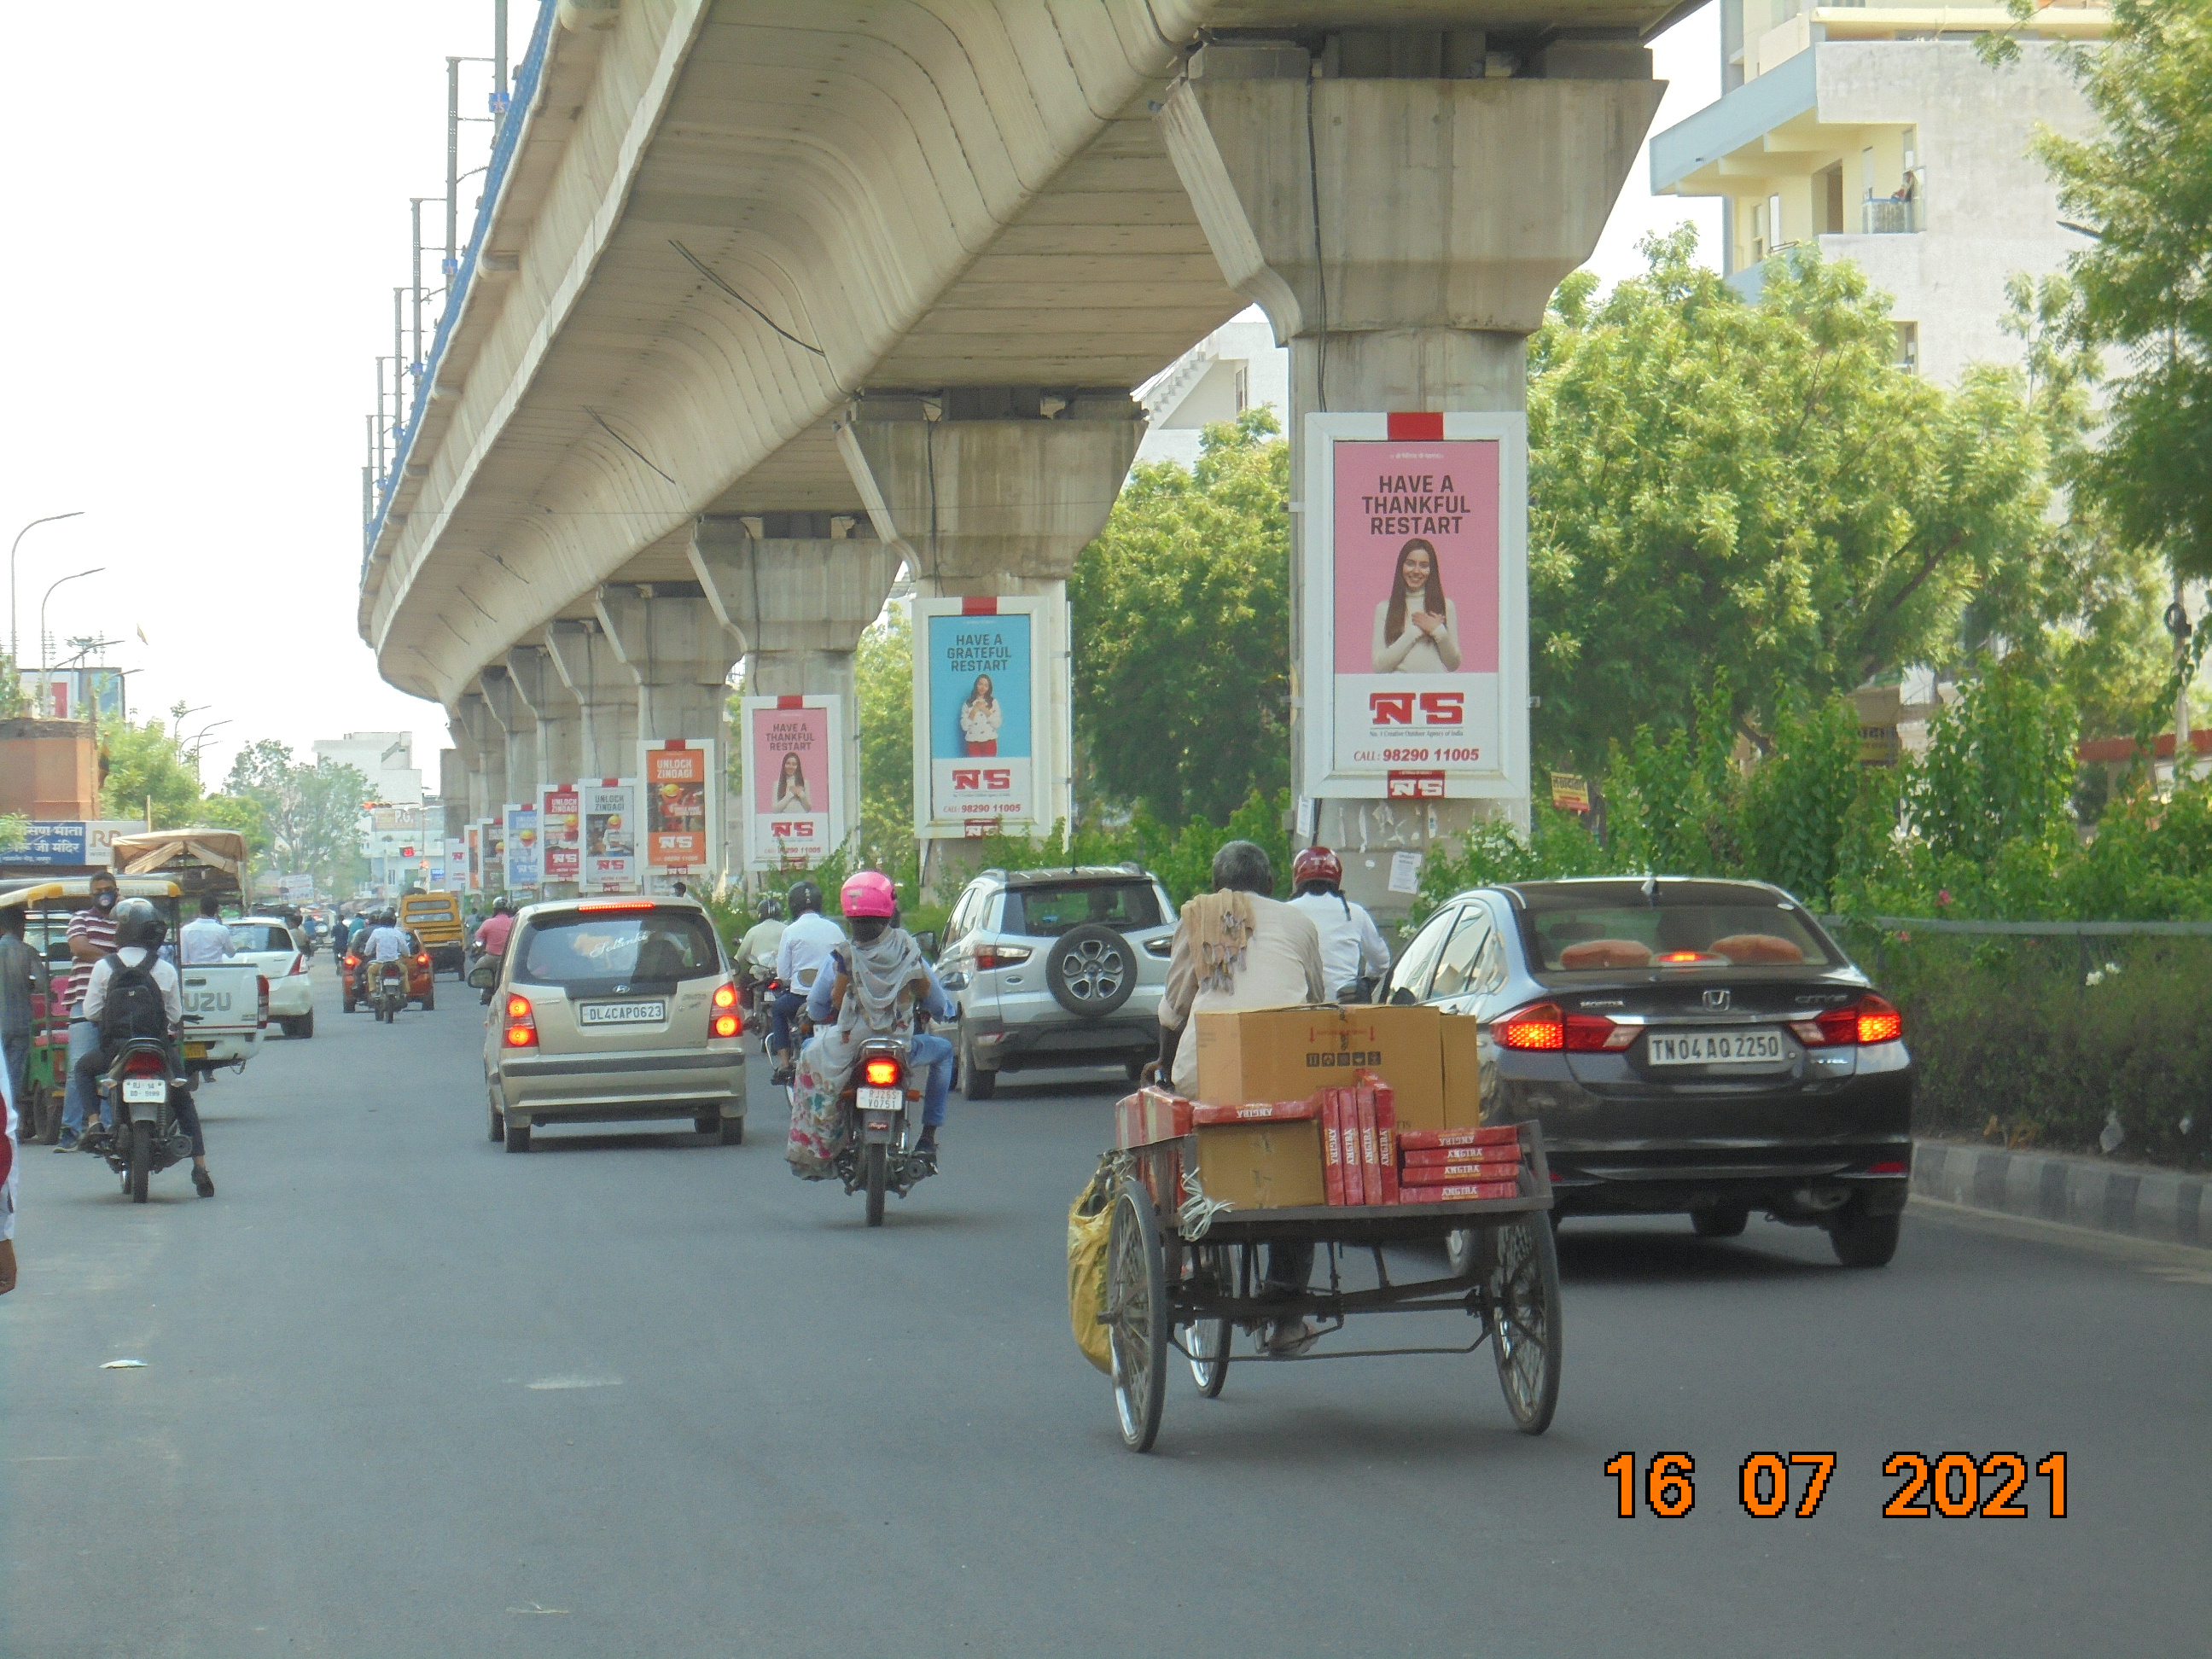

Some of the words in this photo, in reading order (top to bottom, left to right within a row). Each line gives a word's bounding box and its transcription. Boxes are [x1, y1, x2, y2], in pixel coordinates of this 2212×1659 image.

[1378, 475, 1433, 493] HAVE
[1440, 475, 1454, 492] A
[1362, 496, 1470, 514] THANKFUL
[1371, 516, 1463, 535] RESTART
[956, 634, 990, 646] HAVE
[993, 633, 1003, 645] A
[947, 647, 1011, 659] GRATEFUL
[951, 660, 1009, 672] RESTART
[1369, 692, 1464, 725] NS
[772, 724, 799, 732] HAVE
[800, 723, 807, 732] A
[765, 733, 815, 742] THANKFUL
[770, 742, 812, 751] RESTART
[1382, 748, 1429, 761] 98290
[1434, 748, 1480, 761] 11005
[657, 759, 692, 769] UNLOCK
[657, 769, 693, 779] ZINDAGI
[952, 769, 1010, 790] NS
[1389, 779, 1443, 797] NS
[961, 804, 990, 813] 98290
[992, 803, 1022, 812] 11005
[771, 822, 814, 837] NS
[658, 835, 693, 848] NS
[597, 859, 625, 870] NS
[183, 992, 232, 1012] UZU
[590, 1007, 661, 1021] DL4CAP0623
[1736, 1036, 1778, 1057] 2250
[1237, 1109, 1273, 1119] ANGIRA
[1328, 1128, 1338, 1165] ANGIRA
[1344, 1128, 1354, 1165] ANGIRA
[1363, 1127, 1374, 1165] ANGIRA
[1439, 1135, 1475, 1146] ANGIRA
[1379, 1130, 1389, 1166] ANGIRA
[1447, 1148, 1483, 1159] ANGIRA
[1444, 1165, 1481, 1174] ANGIRA
[1441, 1186, 1477, 1196] ANGIRA
